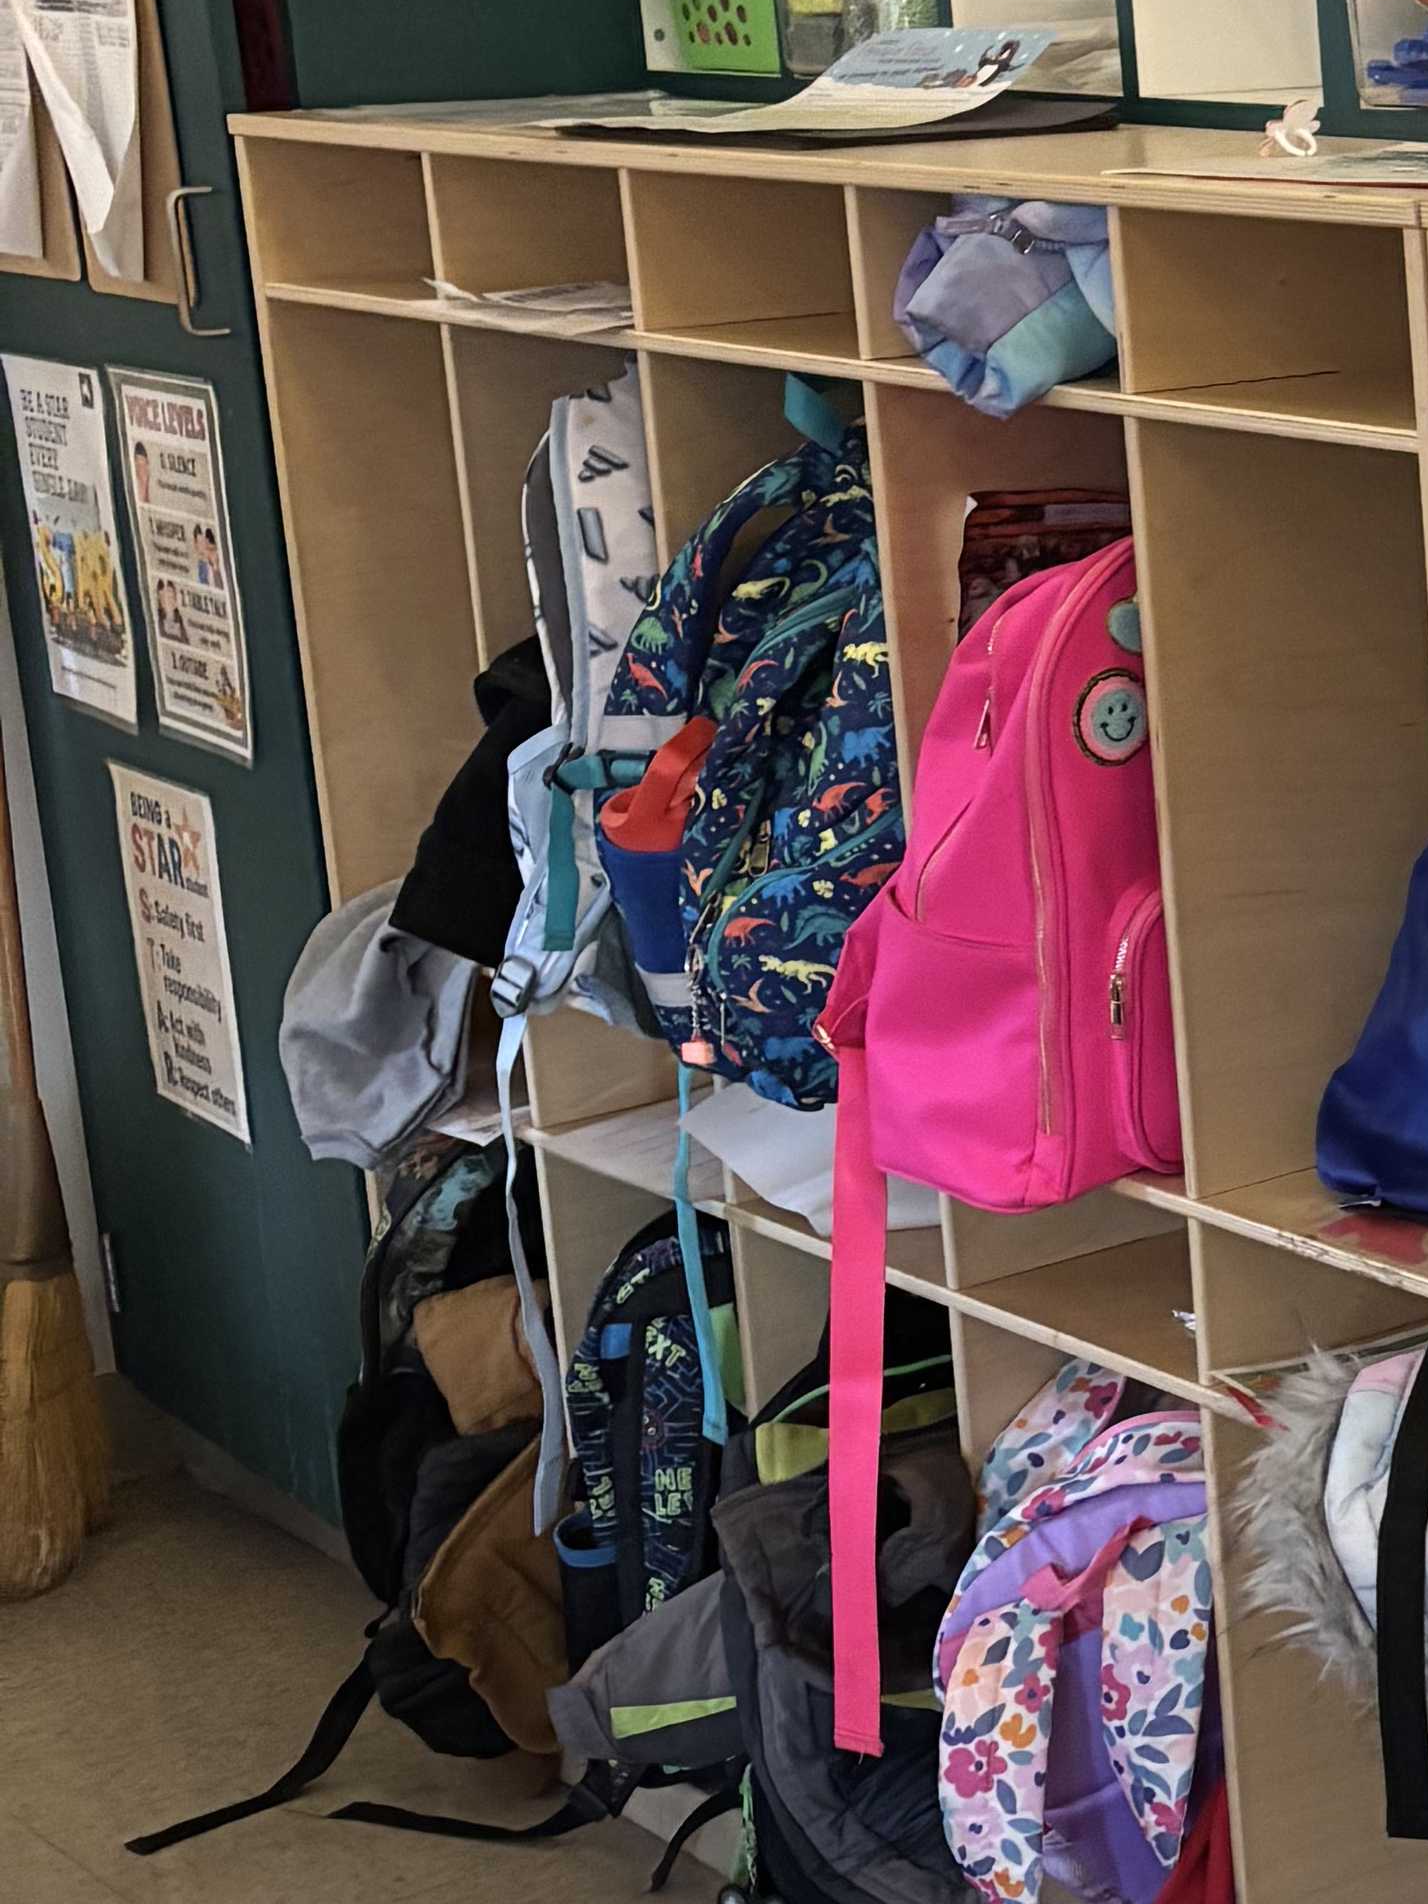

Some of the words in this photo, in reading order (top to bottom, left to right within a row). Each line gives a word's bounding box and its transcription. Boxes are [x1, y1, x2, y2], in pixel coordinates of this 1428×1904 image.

[125, 395, 161, 432] VOICE
[160, 402, 206, 441] LEVELS
[129, 791, 163, 826] BEING
[128, 820, 185, 889] STAR
[159, 942, 182, 975] Take
